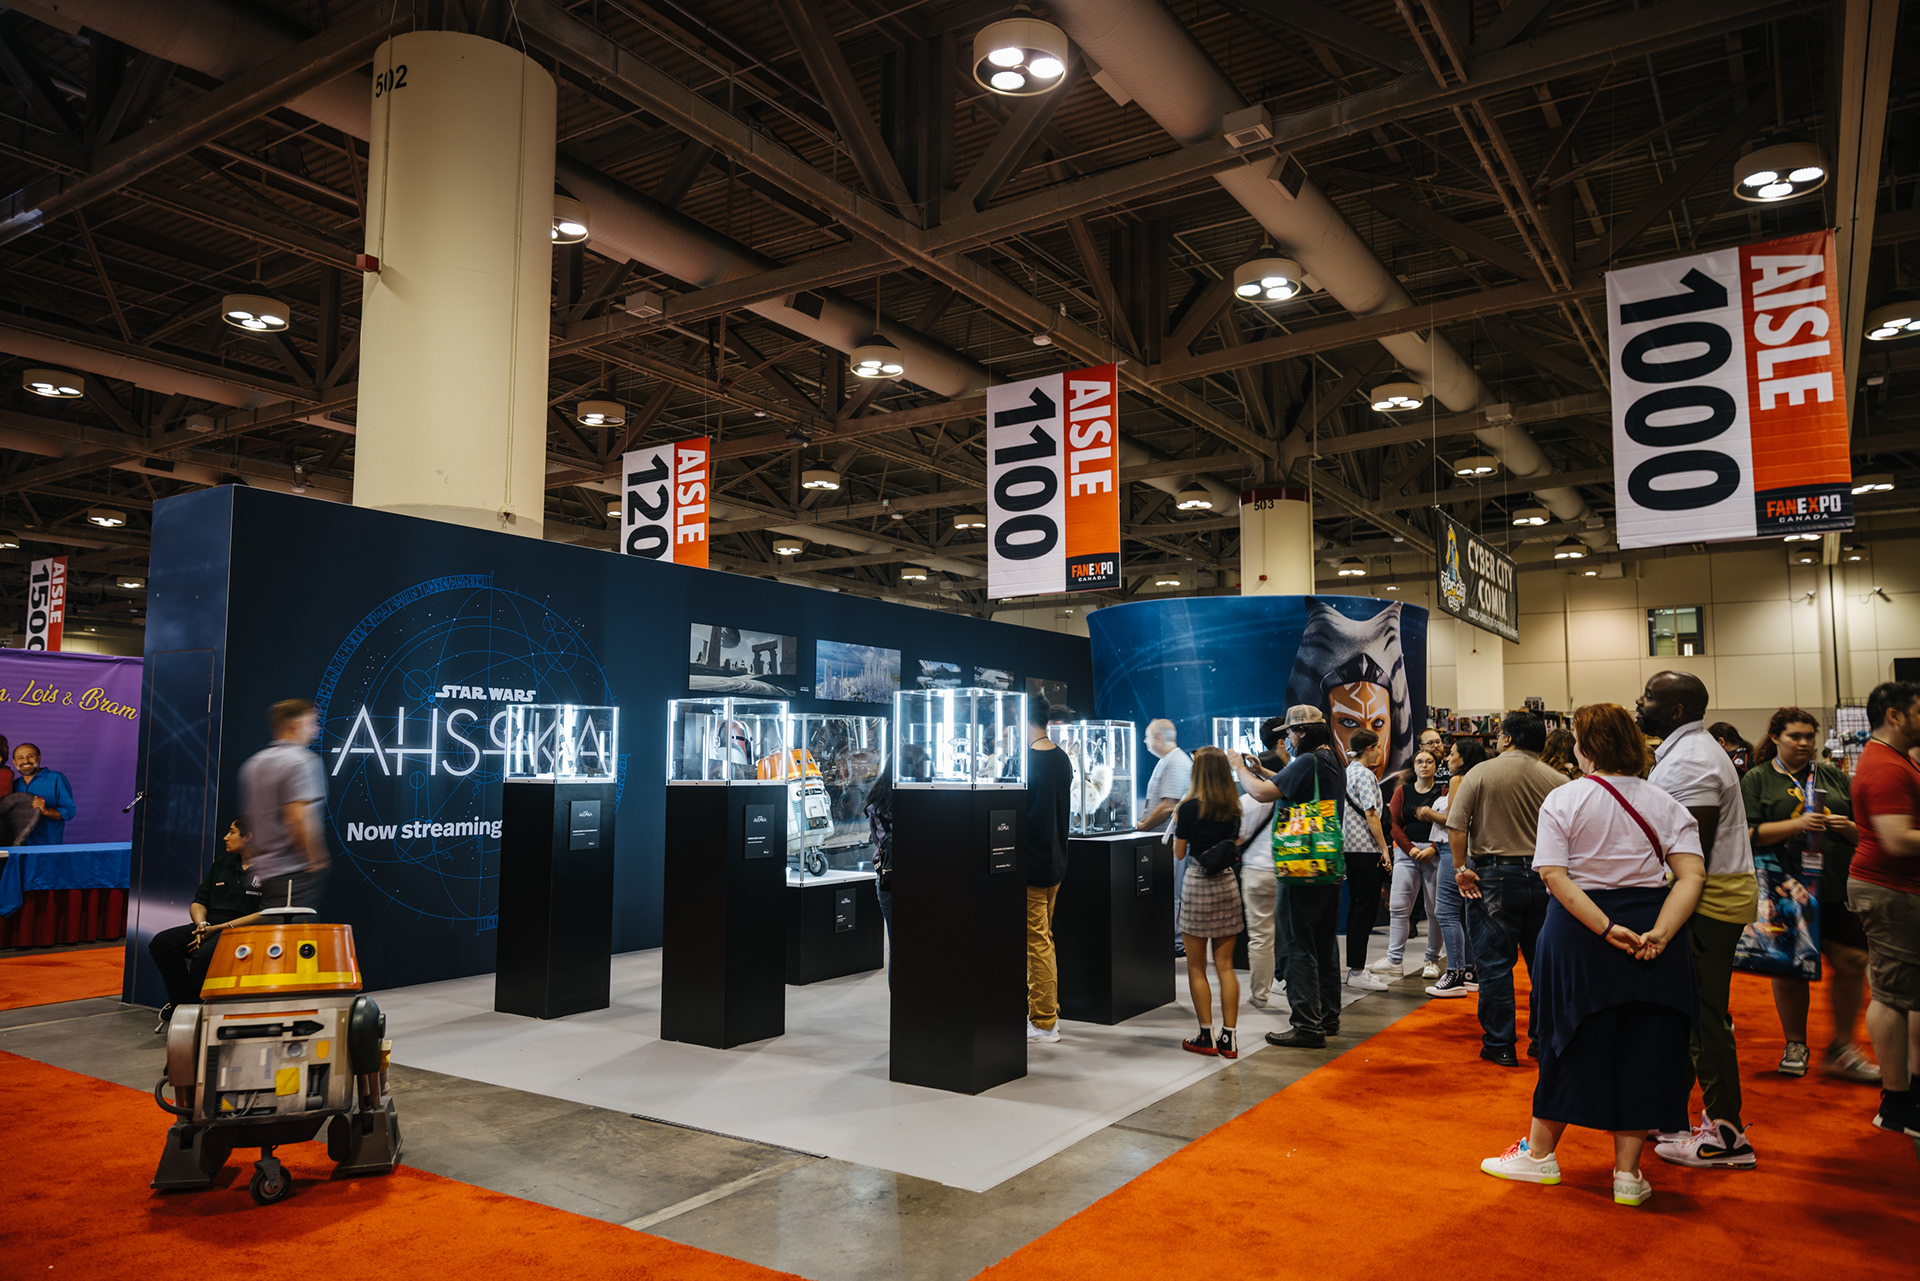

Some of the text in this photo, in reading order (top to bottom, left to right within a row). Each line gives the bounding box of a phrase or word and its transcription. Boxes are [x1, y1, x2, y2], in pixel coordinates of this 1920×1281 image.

[376, 64, 408, 98] 502
[1750, 254, 1834, 411] AISLE
[1620, 267, 1741, 511] 1000
[1069, 380, 1112, 497] AISLE
[677, 448, 706, 545] AISLE
[994, 386, 1058, 561] 1100
[1254, 499, 1275, 511] 503
[1779, 513, 1829, 523] CANADA
[1468, 539, 1513, 592] CYBER CITY
[50, 561, 65, 624] AISLE
[1478, 578, 1507, 620] COMIX
[17, 679, 59, 706] Lois
[62, 691, 74, 706] &
[78, 687, 138, 720] Bram
[435, 684, 537, 703] STAR WARS
[346, 815, 503, 842] Now streaming
